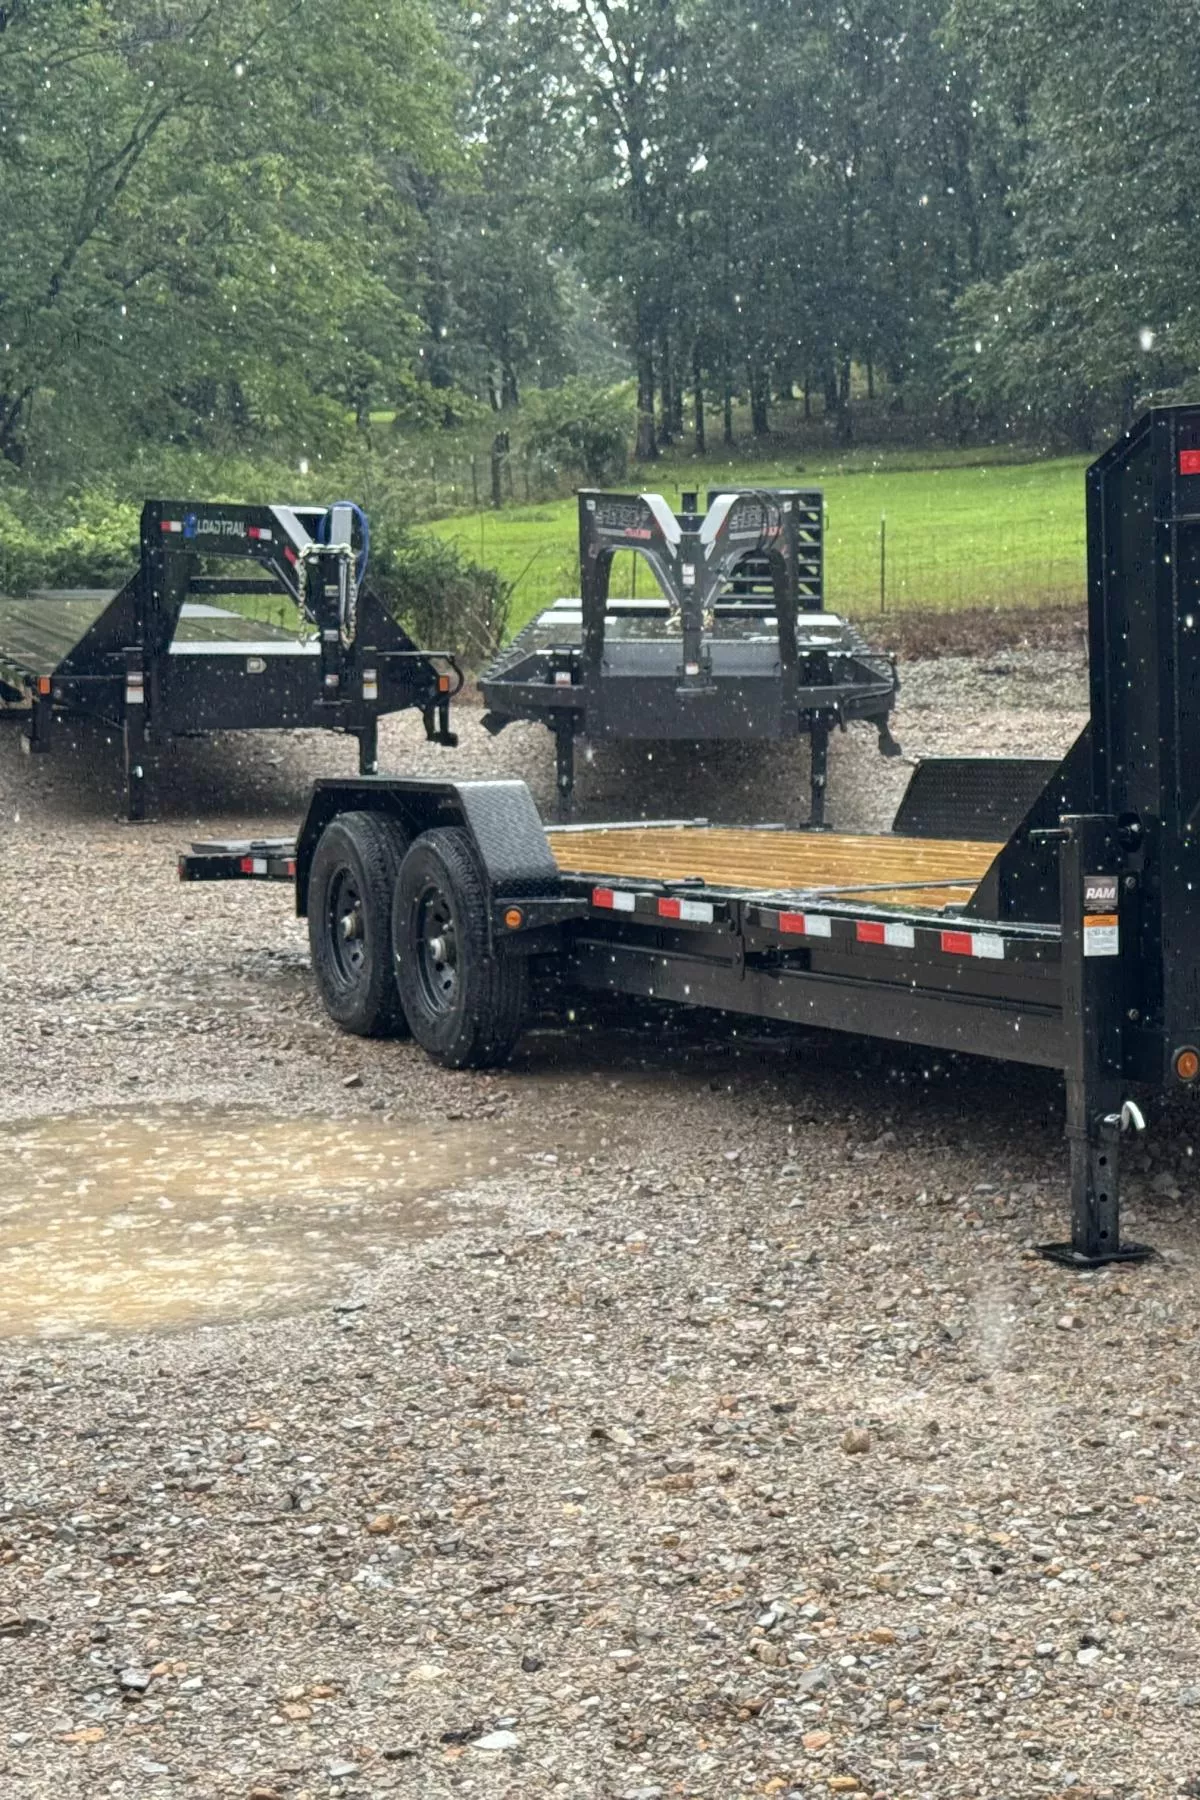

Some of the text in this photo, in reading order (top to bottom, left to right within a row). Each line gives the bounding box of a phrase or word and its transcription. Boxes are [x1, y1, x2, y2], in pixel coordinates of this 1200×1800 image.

[197, 519, 247, 537] LOAD TRAIL
[1086, 887, 1116, 900] RAM
